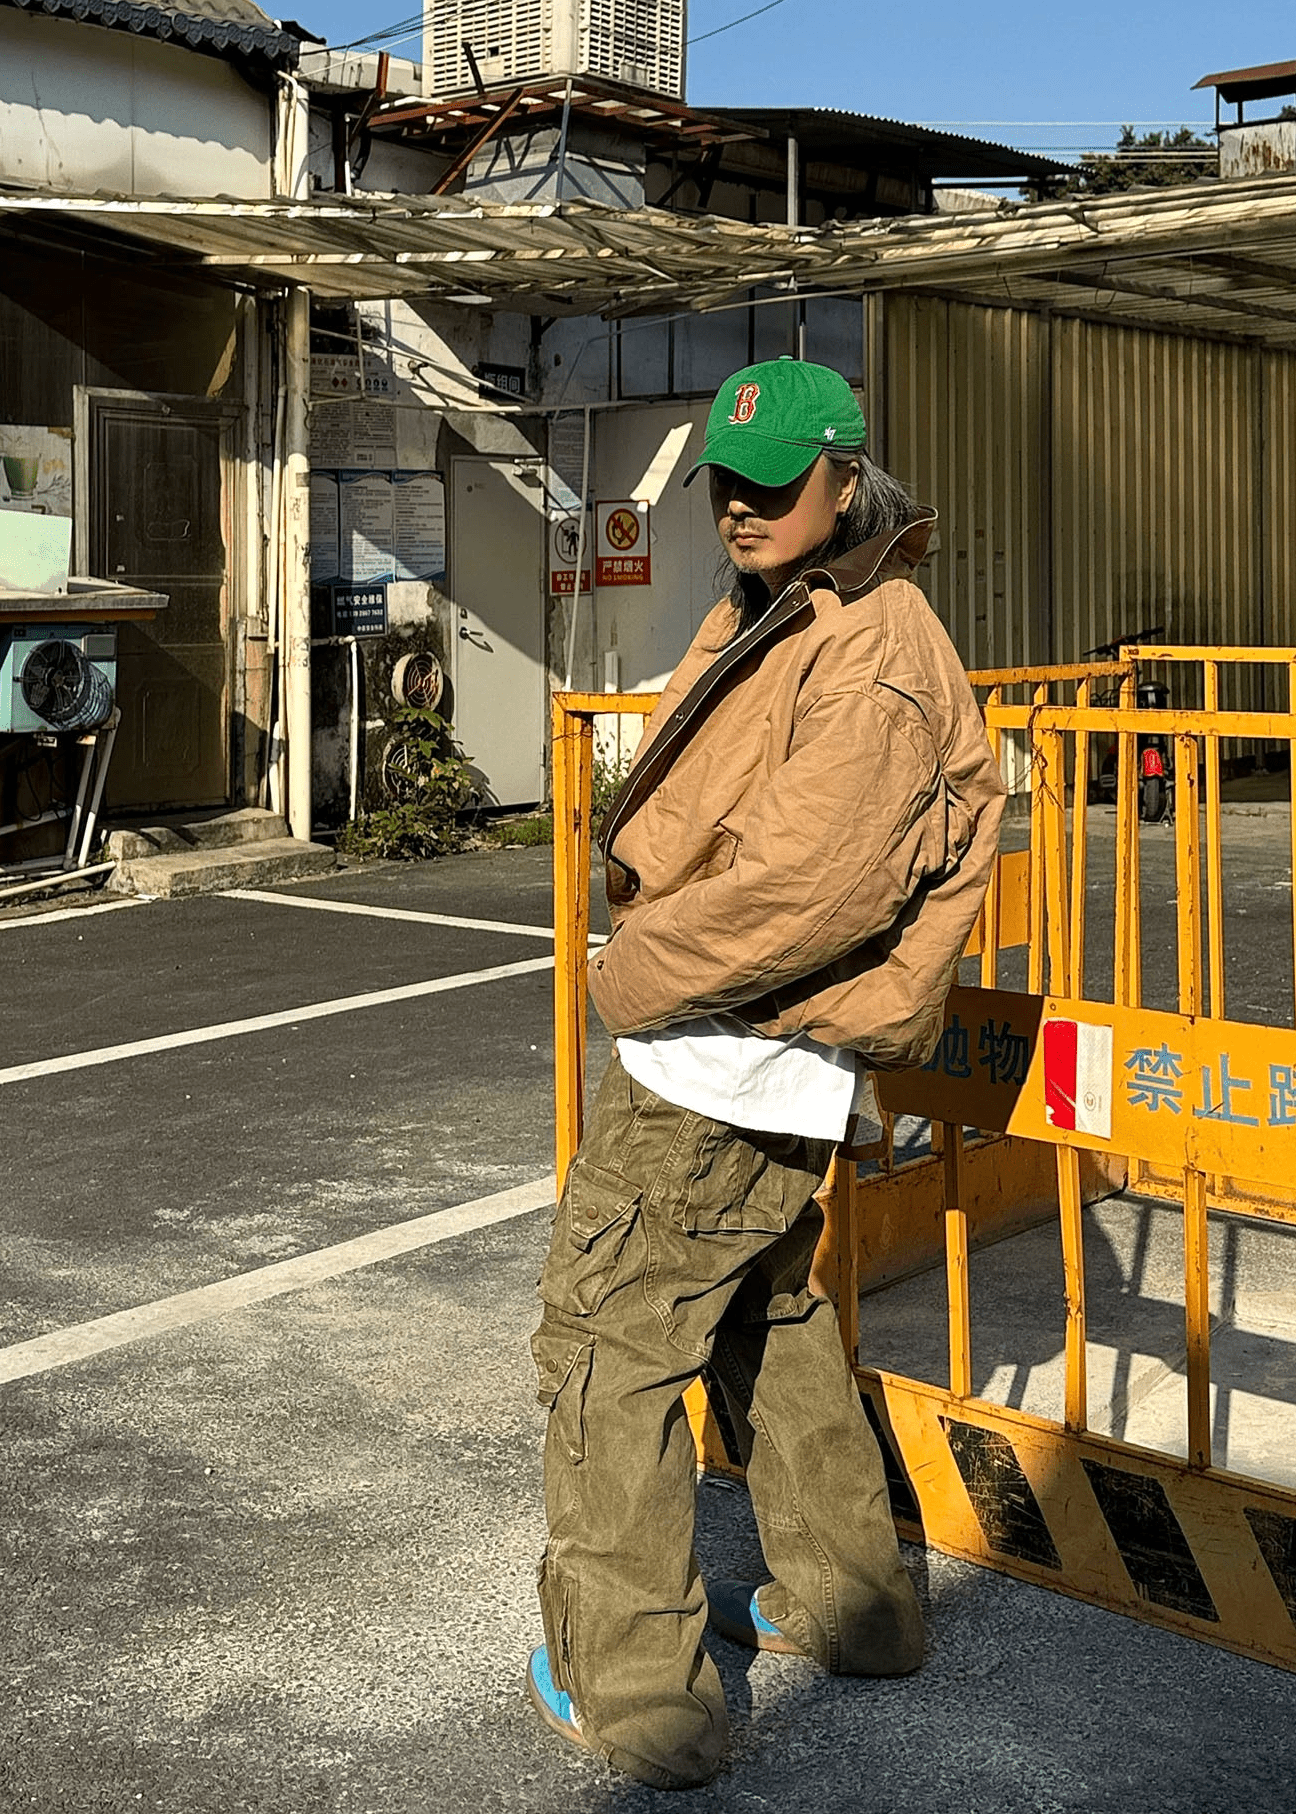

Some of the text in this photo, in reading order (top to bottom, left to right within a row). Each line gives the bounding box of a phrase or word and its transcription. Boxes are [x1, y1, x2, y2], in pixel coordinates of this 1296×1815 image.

[728, 383, 760, 424] B
[602, 560, 644, 573] 严禁烟火
